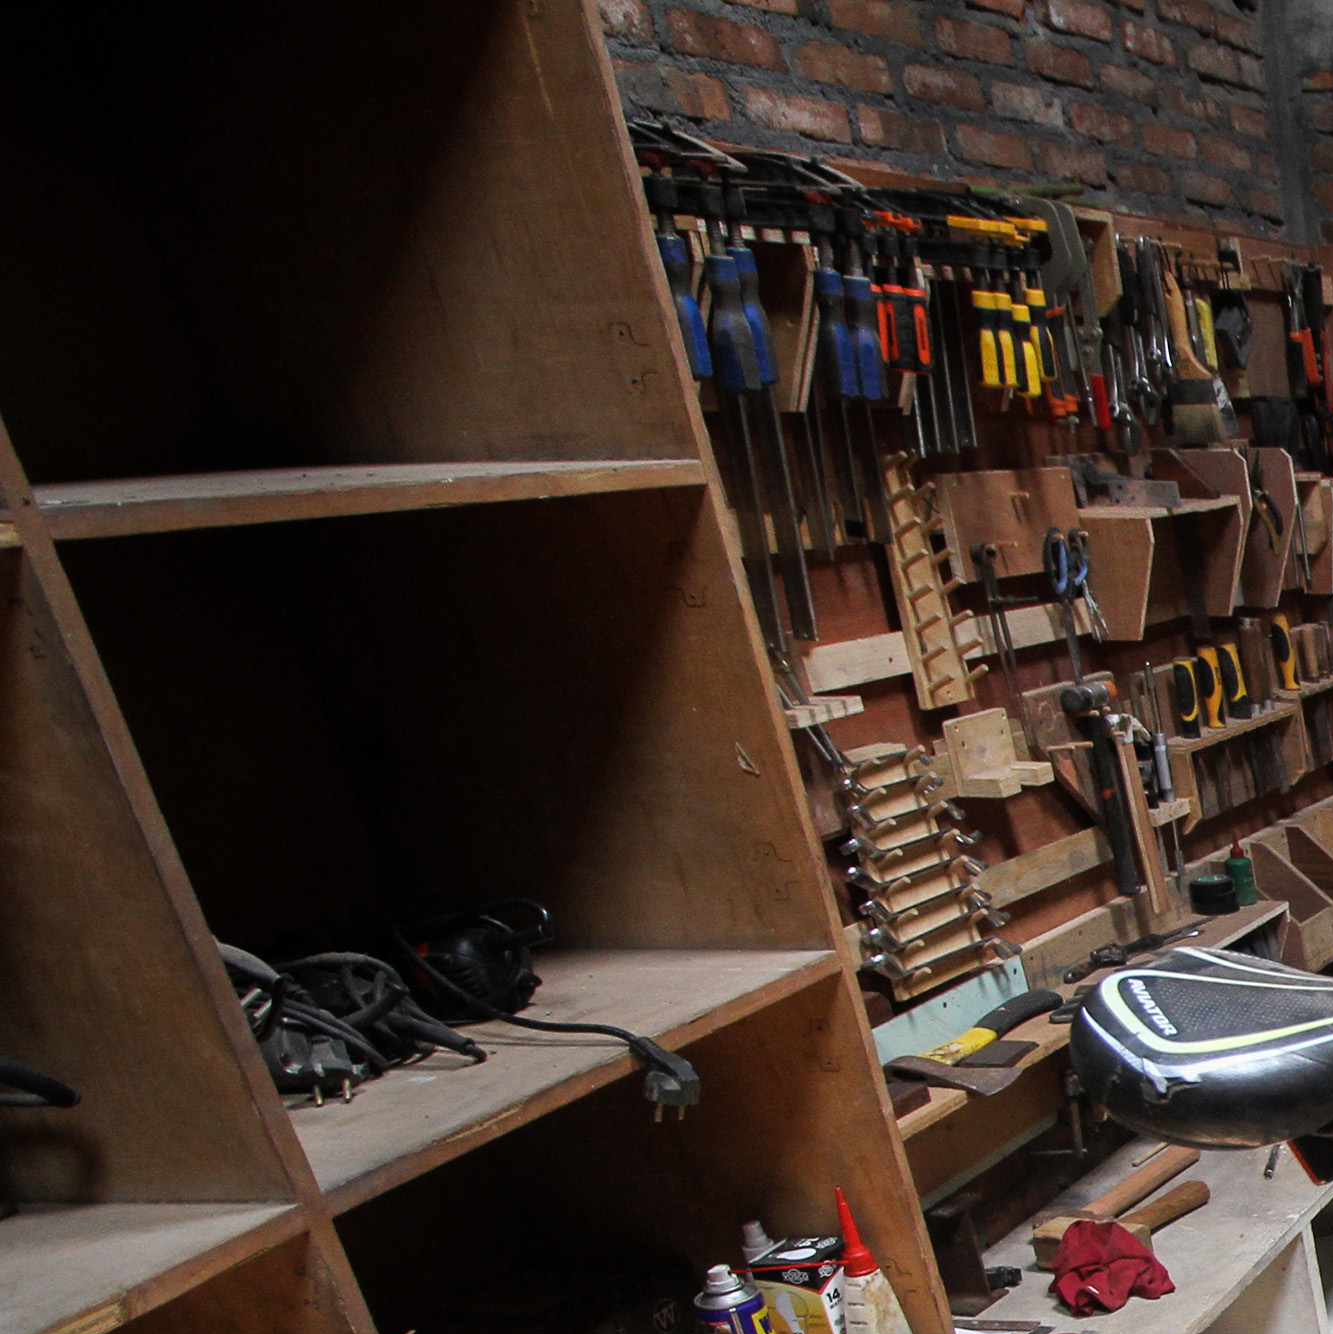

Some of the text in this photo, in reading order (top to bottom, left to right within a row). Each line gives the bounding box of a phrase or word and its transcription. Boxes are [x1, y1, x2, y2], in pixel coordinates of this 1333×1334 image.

[1127, 978, 1178, 1036] AVIATOR
[826, 1288, 840, 1303] 14
[652, 1305, 677, 1328] W
